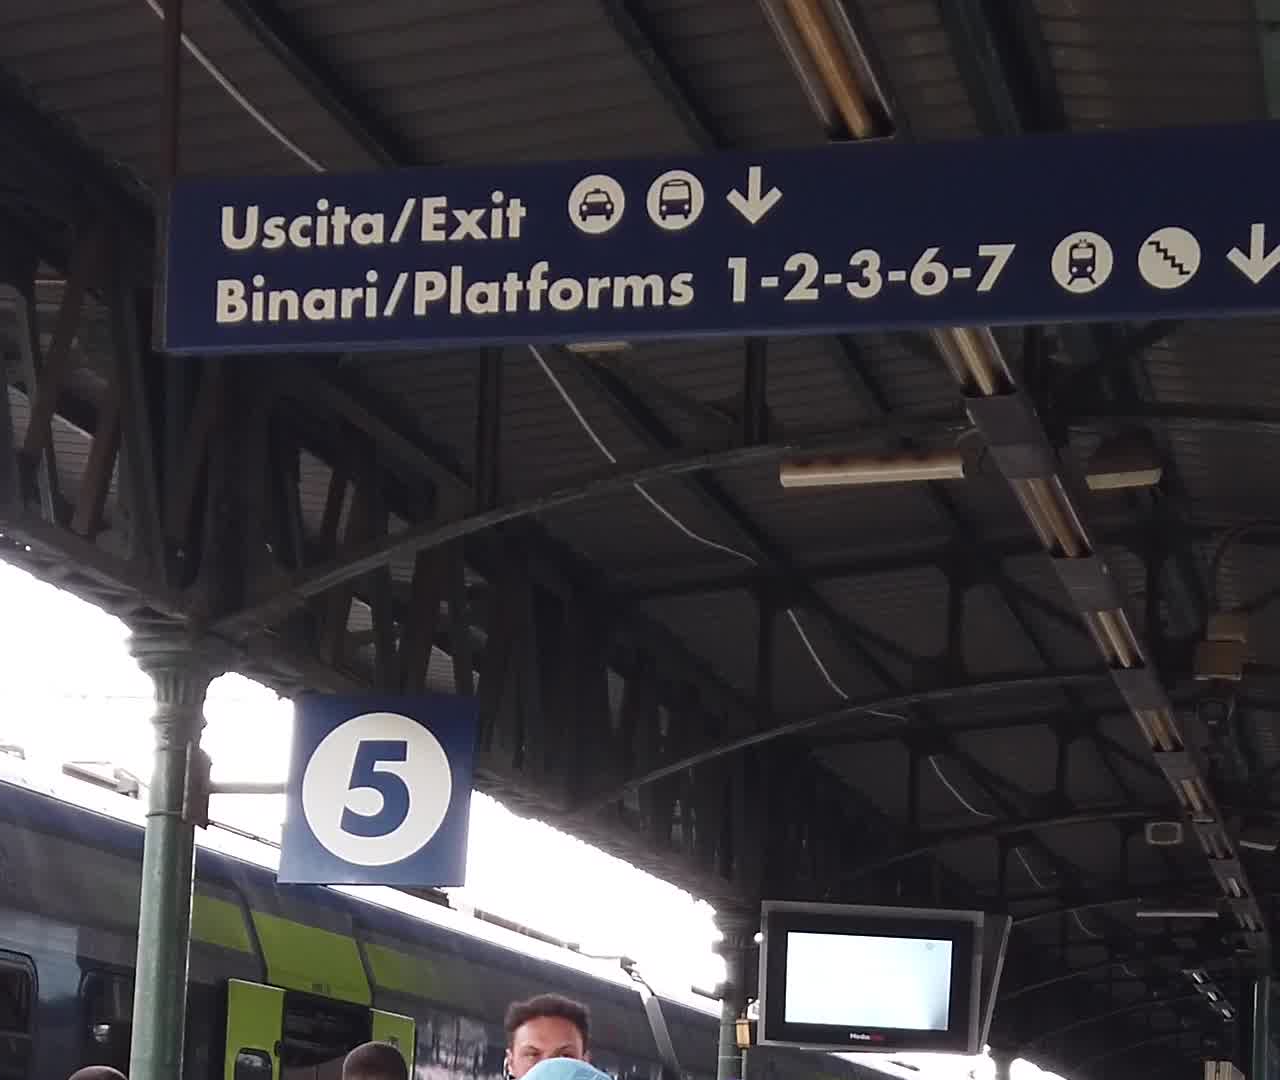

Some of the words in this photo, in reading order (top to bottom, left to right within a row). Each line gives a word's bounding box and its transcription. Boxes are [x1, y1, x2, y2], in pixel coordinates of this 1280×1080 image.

[221, 190, 526, 250] Uscita/Exit
[216, 261, 694, 323] Binari/Platforms
[728, 243, 1016, 302] 1-2-3-6-7
[340, 739, 412, 838] 5
